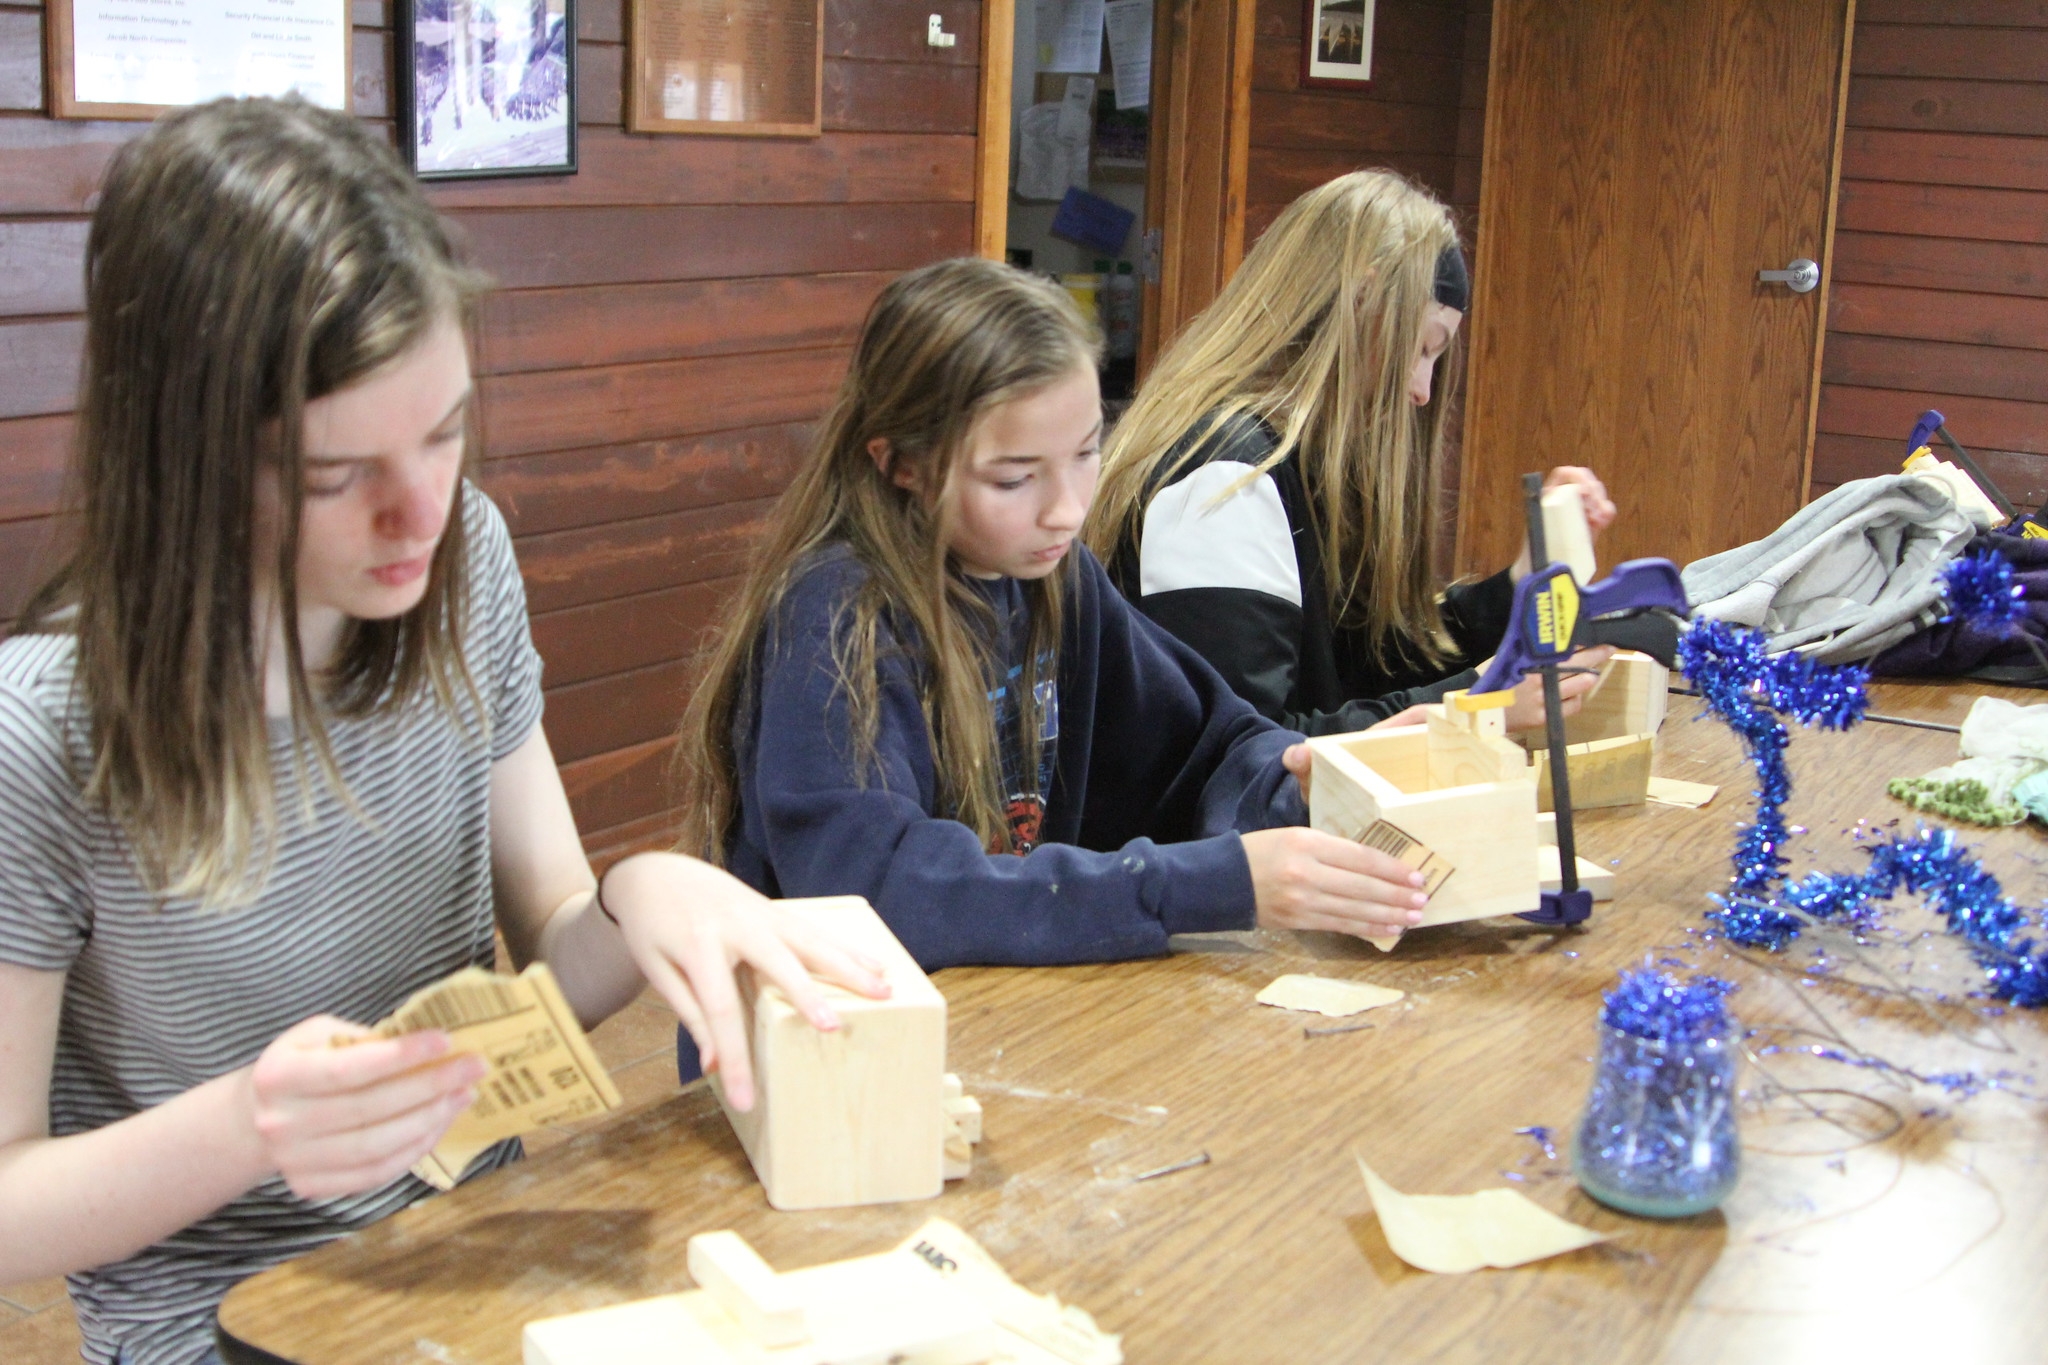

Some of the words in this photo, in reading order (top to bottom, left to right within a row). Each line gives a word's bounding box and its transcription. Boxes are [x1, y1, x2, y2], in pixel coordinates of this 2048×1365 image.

[98, 12, 138, 23] Information
[252, 13, 280, 22] Financial
[1536, 591, 1554, 644] IRWIN
